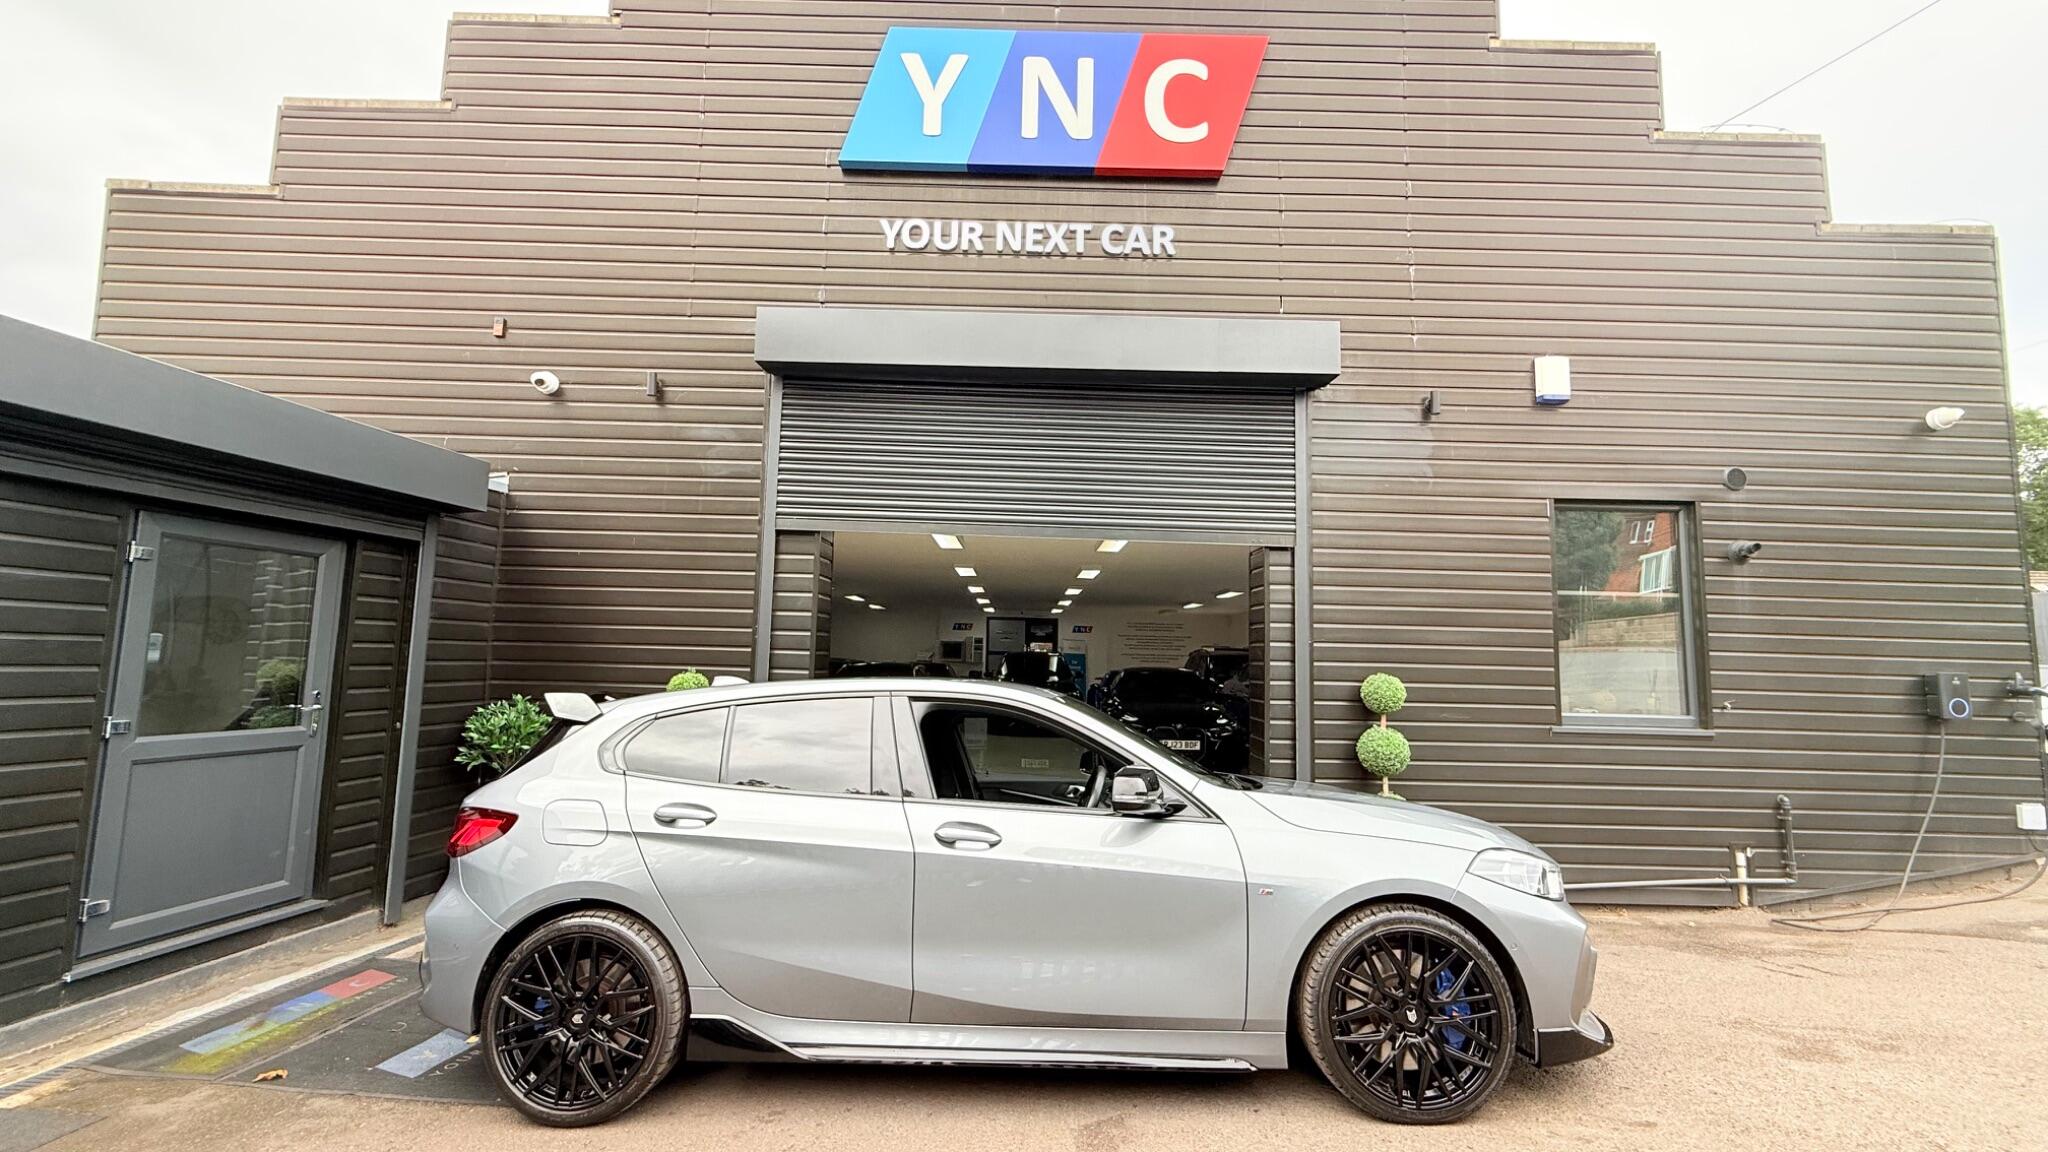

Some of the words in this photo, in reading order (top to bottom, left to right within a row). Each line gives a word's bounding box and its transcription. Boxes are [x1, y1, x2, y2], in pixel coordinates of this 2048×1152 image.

[900, 52, 1209, 144] YNC
[880, 218, 985, 252] YOUR
[995, 221, 1091, 254] NEXT
[1100, 223, 1176, 257] CAR
